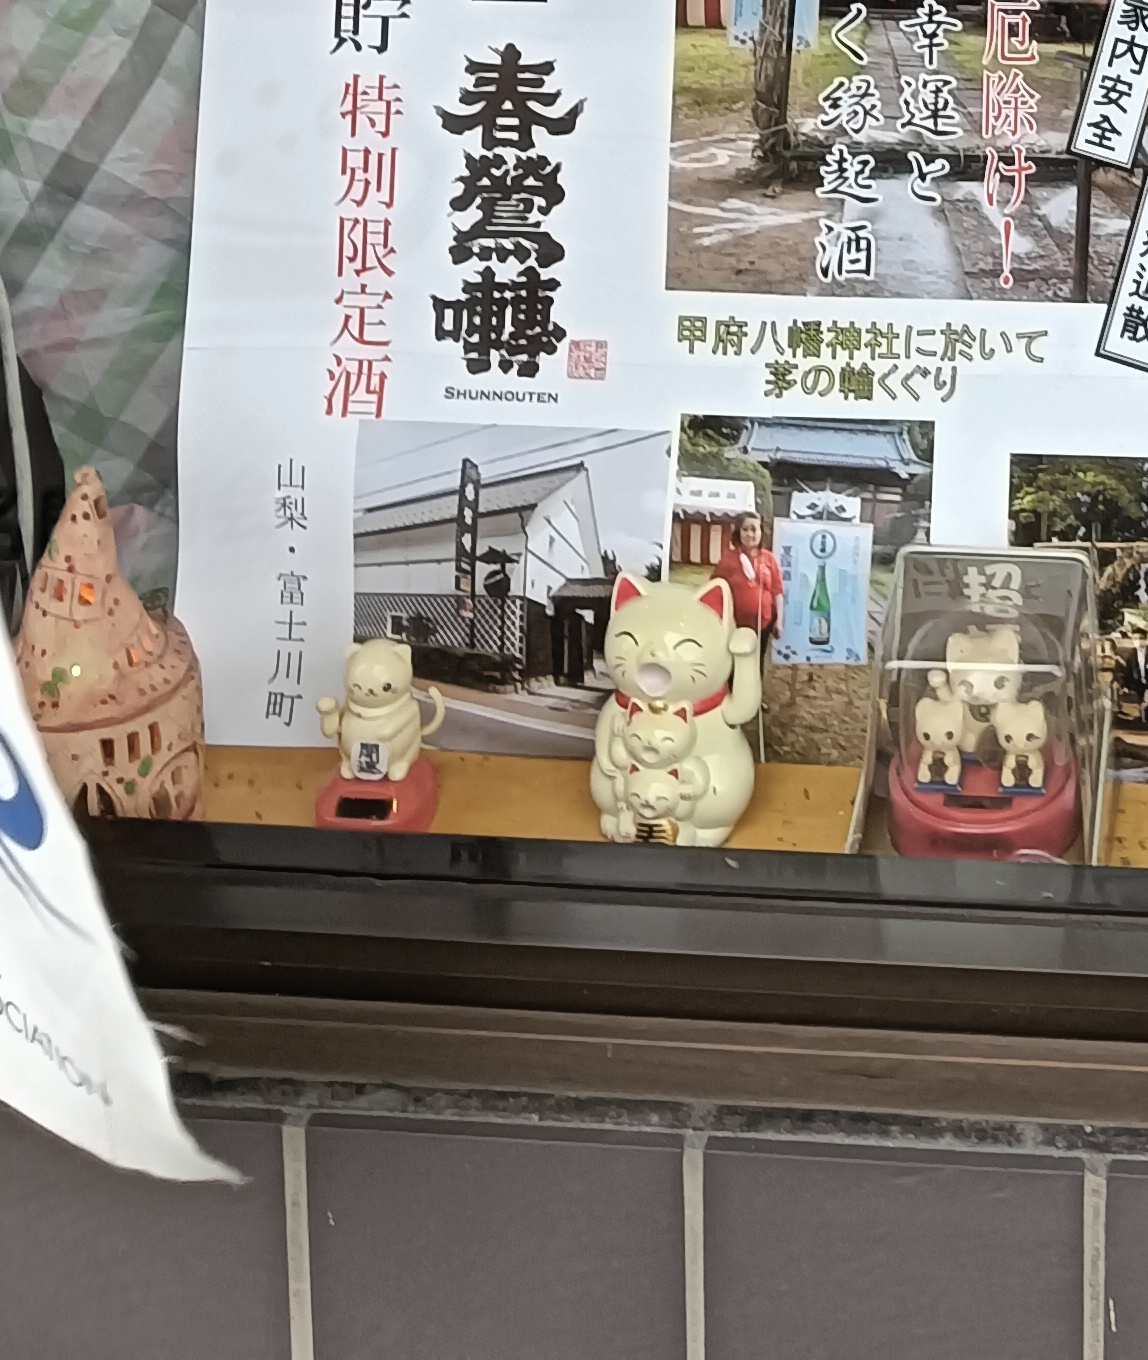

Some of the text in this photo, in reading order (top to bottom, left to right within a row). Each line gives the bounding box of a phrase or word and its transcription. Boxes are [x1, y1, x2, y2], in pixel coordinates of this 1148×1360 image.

[323, 73, 405, 420] 特別限定酒
[430, 42, 589, 379] 春鶯囀
[442, 385, 561, 405] SHUNNOUTEN
[677, 316, 1050, 363] 甲府八幡神社に於いて
[764, 360, 958, 402] 茅の輪くぐり
[265, 455, 310, 730] 山梨・富士川町
